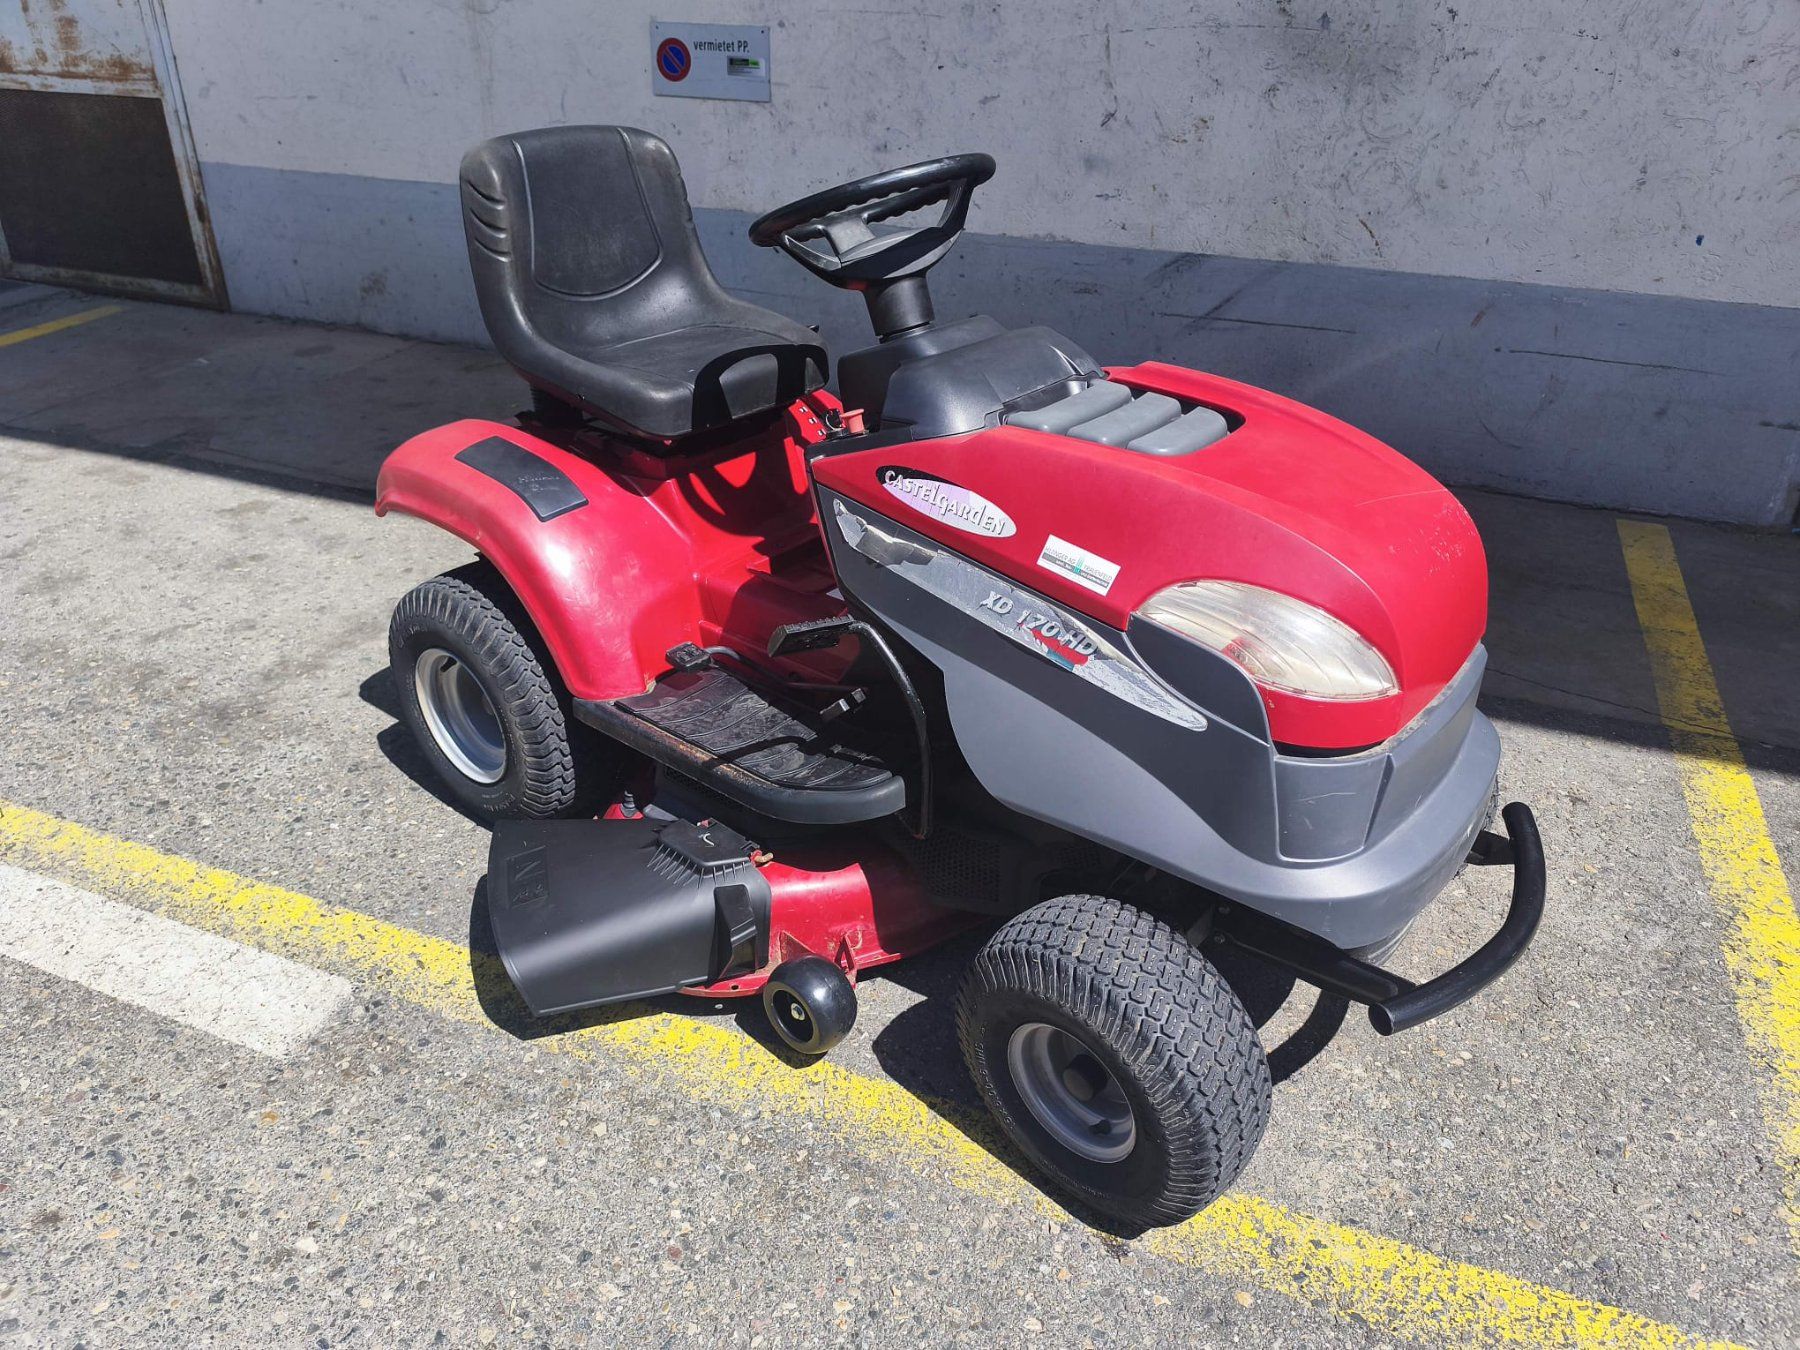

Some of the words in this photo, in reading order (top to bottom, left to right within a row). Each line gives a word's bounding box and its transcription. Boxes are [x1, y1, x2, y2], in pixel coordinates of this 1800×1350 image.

[693, 38, 735, 52] vermietet
[980, 591, 1014, 615] XD
[1016, 609, 1061, 637] 170
[1060, 629, 1098, 656] HD
